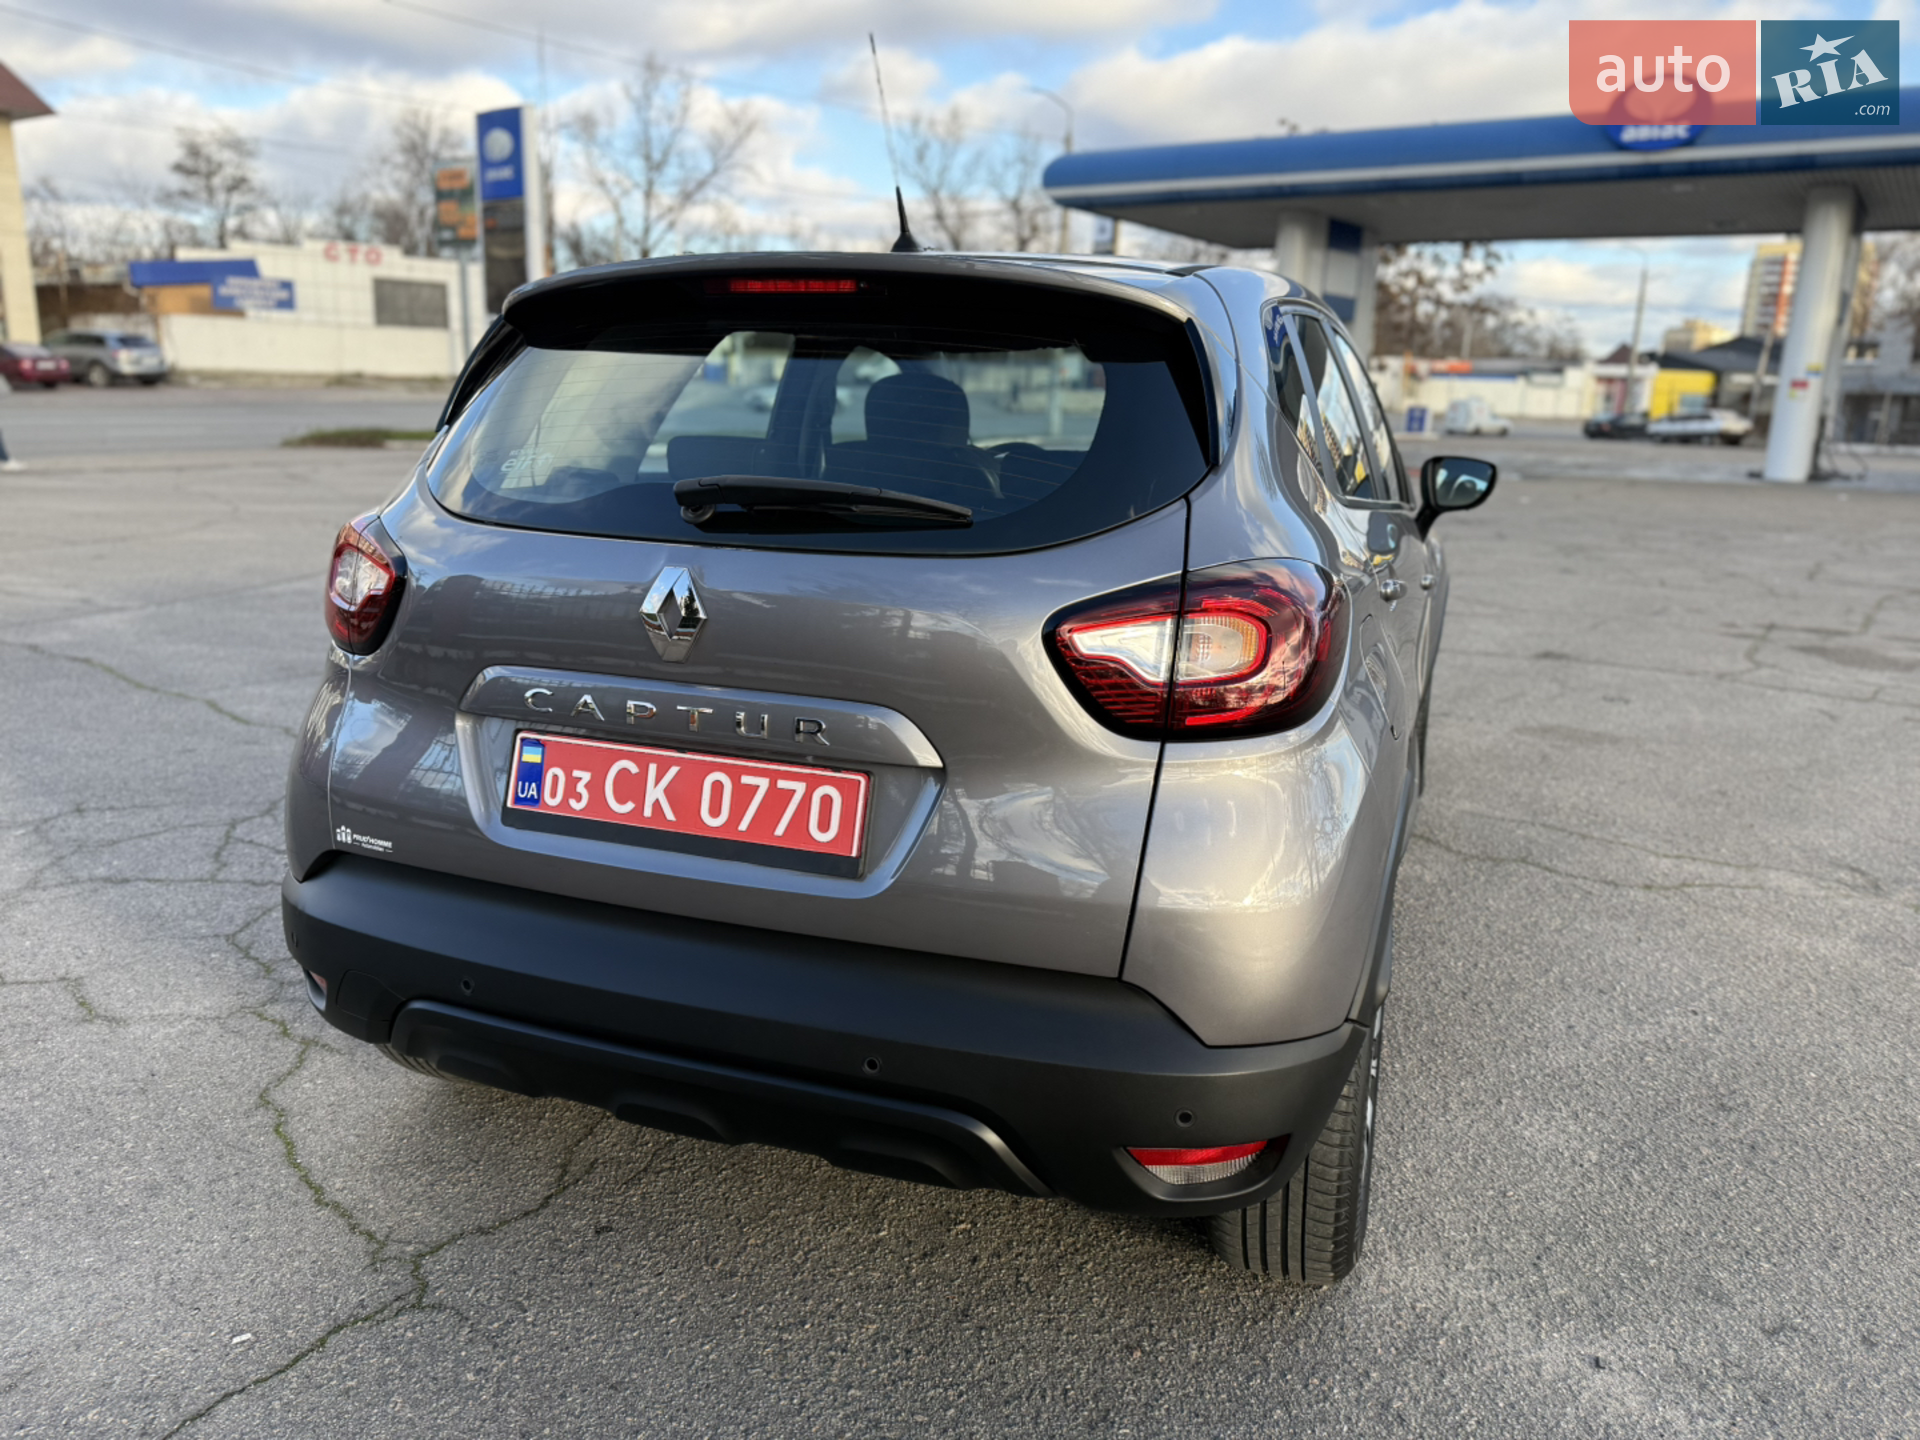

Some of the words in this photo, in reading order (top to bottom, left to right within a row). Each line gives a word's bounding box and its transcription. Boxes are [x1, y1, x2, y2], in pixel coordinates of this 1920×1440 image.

[524, 688, 831, 746] CAPTUR
[517, 780, 539, 799] UA
[543, 767, 592, 811] 03
[604, 759, 681, 822] CK
[700, 771, 842, 843] 0770
